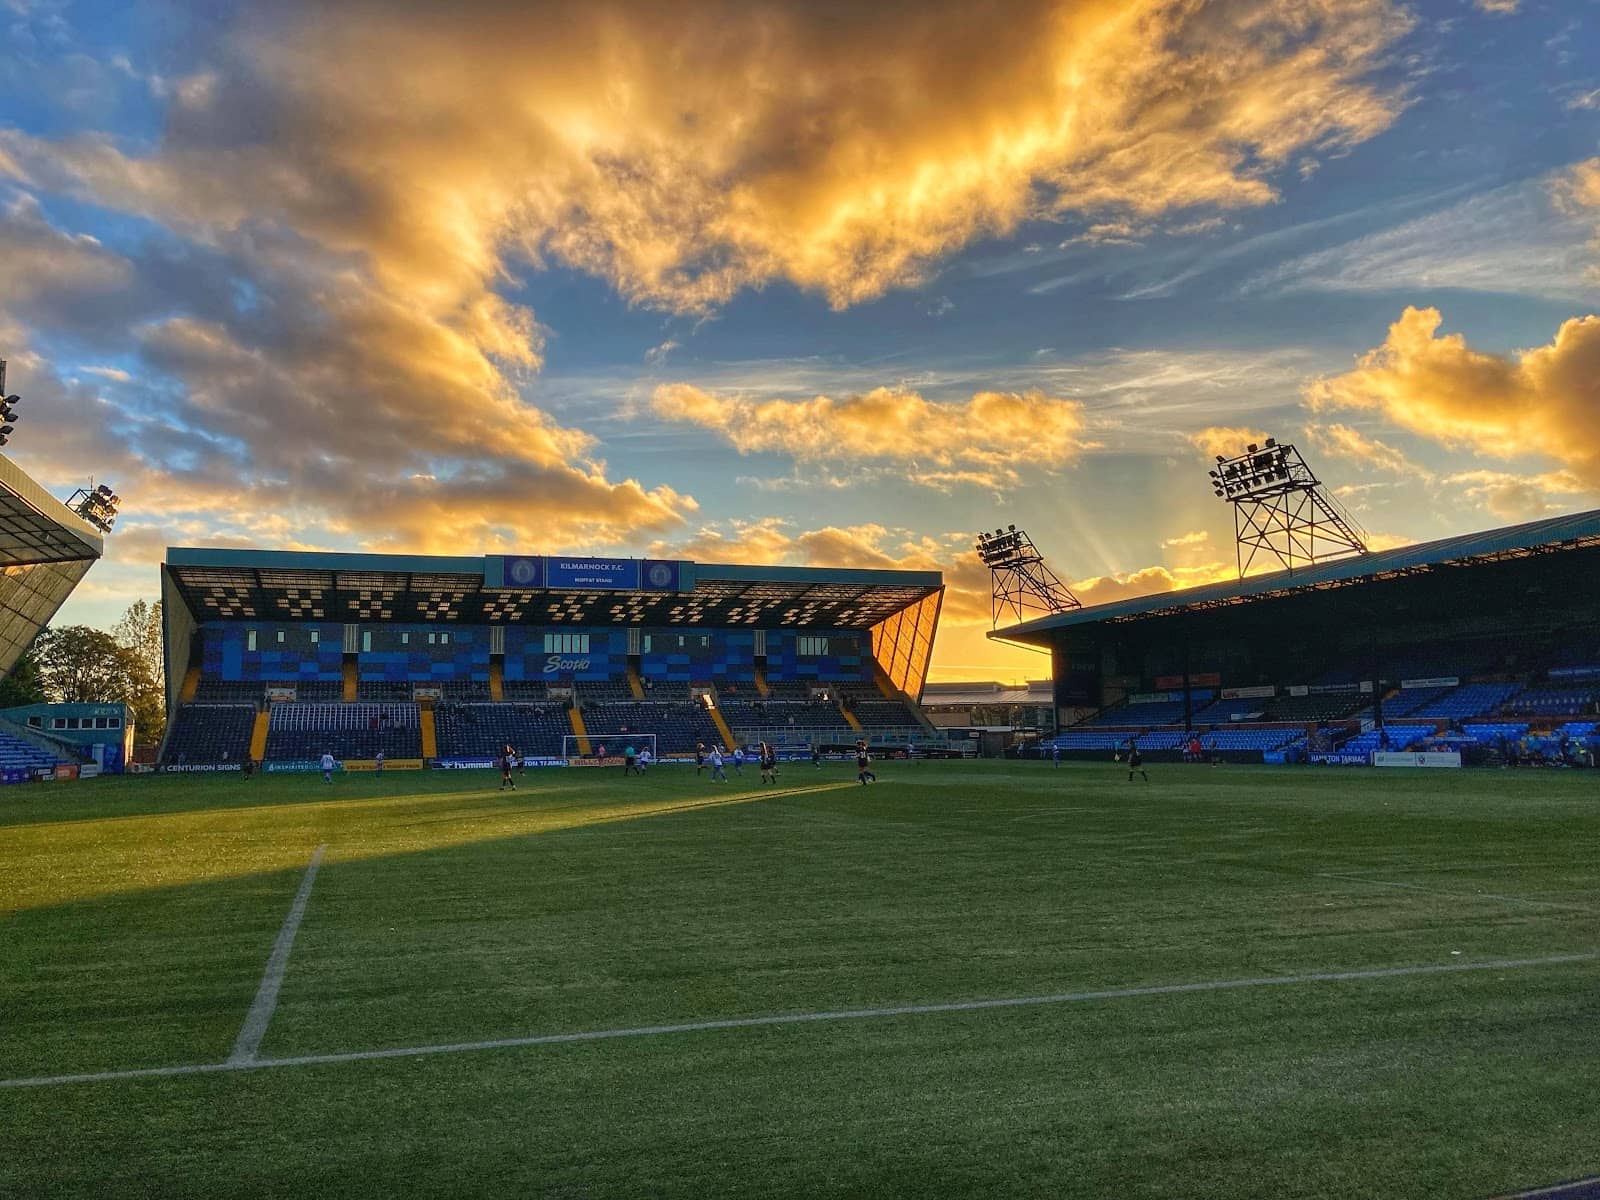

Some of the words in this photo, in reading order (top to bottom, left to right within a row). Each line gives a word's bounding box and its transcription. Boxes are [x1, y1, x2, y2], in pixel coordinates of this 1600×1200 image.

[560, 563, 610, 571] KILMARNOCK
[167, 764, 215, 772] CENTURION
[454, 761, 493, 769] hummel
